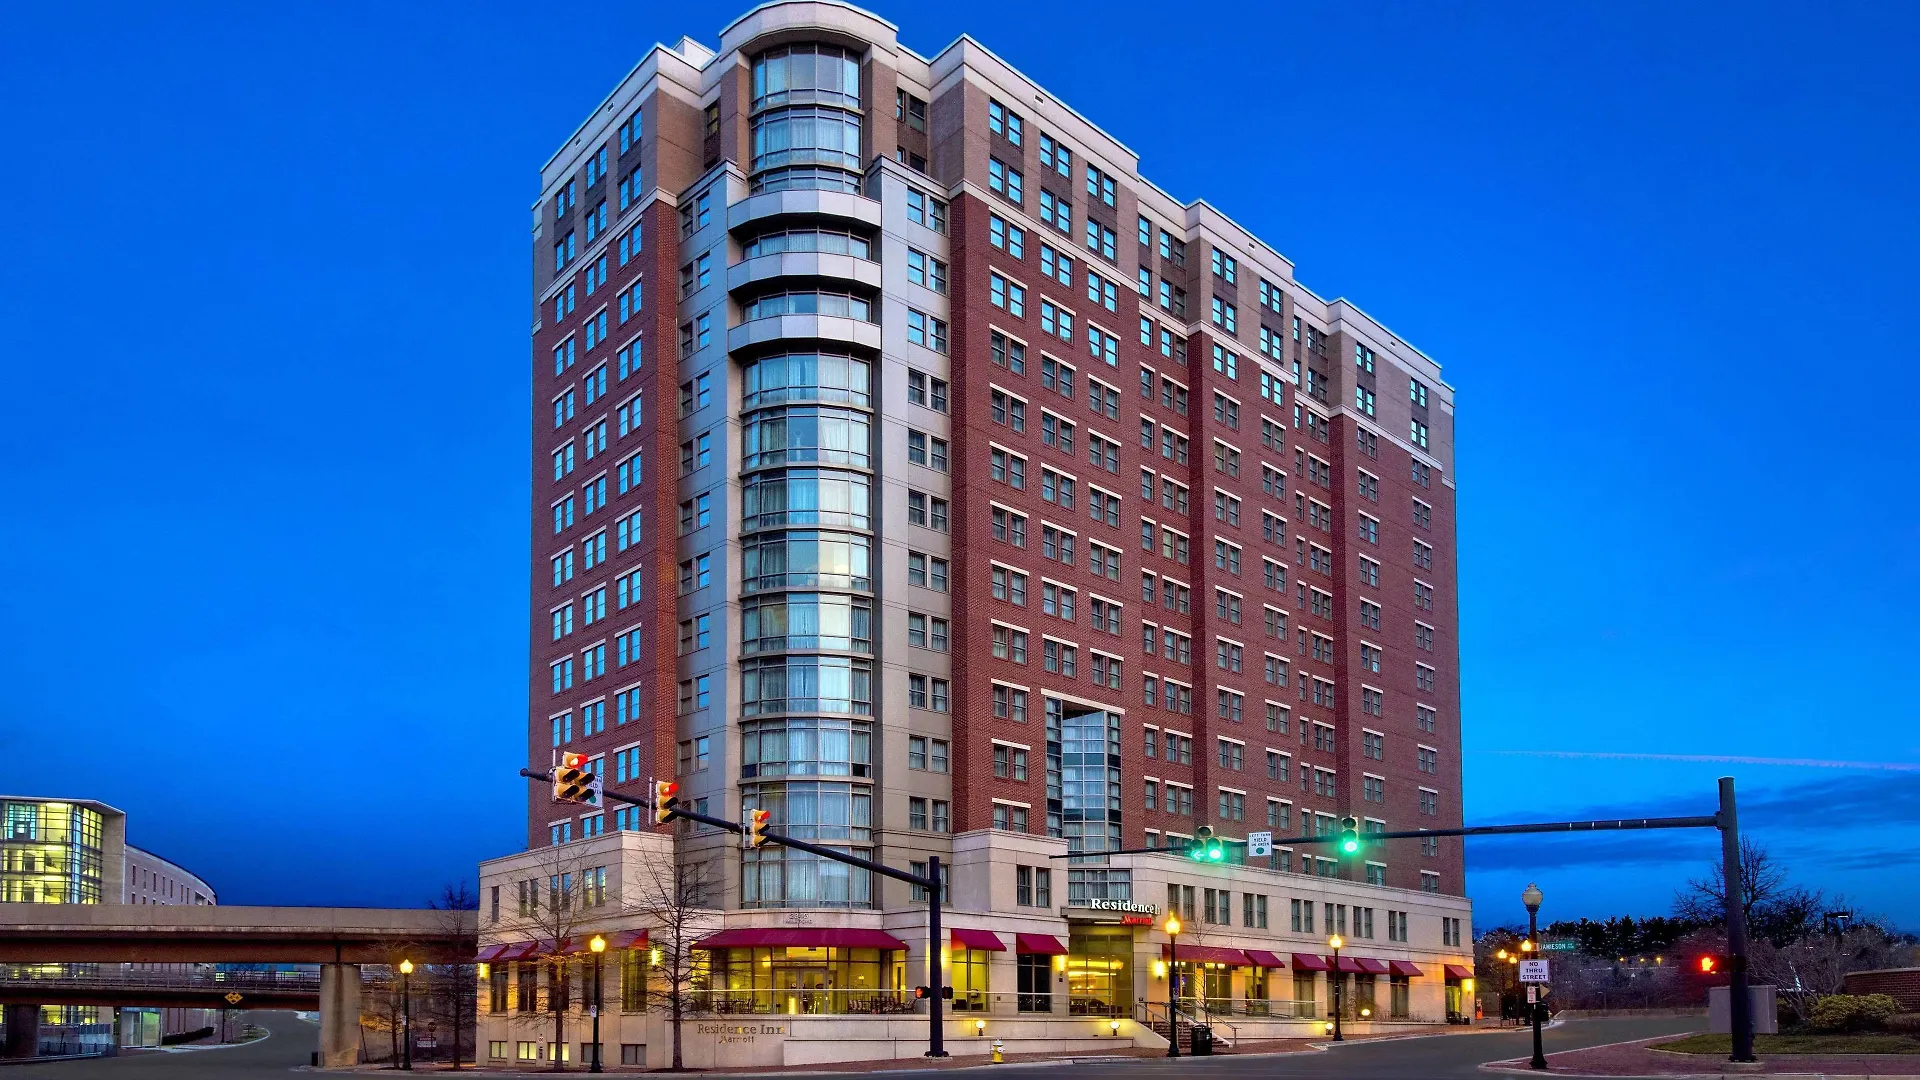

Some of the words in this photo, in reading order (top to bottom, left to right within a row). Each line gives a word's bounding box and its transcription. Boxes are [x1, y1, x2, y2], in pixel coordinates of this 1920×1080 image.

[1090, 898, 1154, 914] Residence
[1121, 914, 1152, 925] Marriott
[697, 1023, 757, 1034] Residence
[760, 1024, 786, 1035] Inn
[718, 1036, 754, 1044] Marriott
